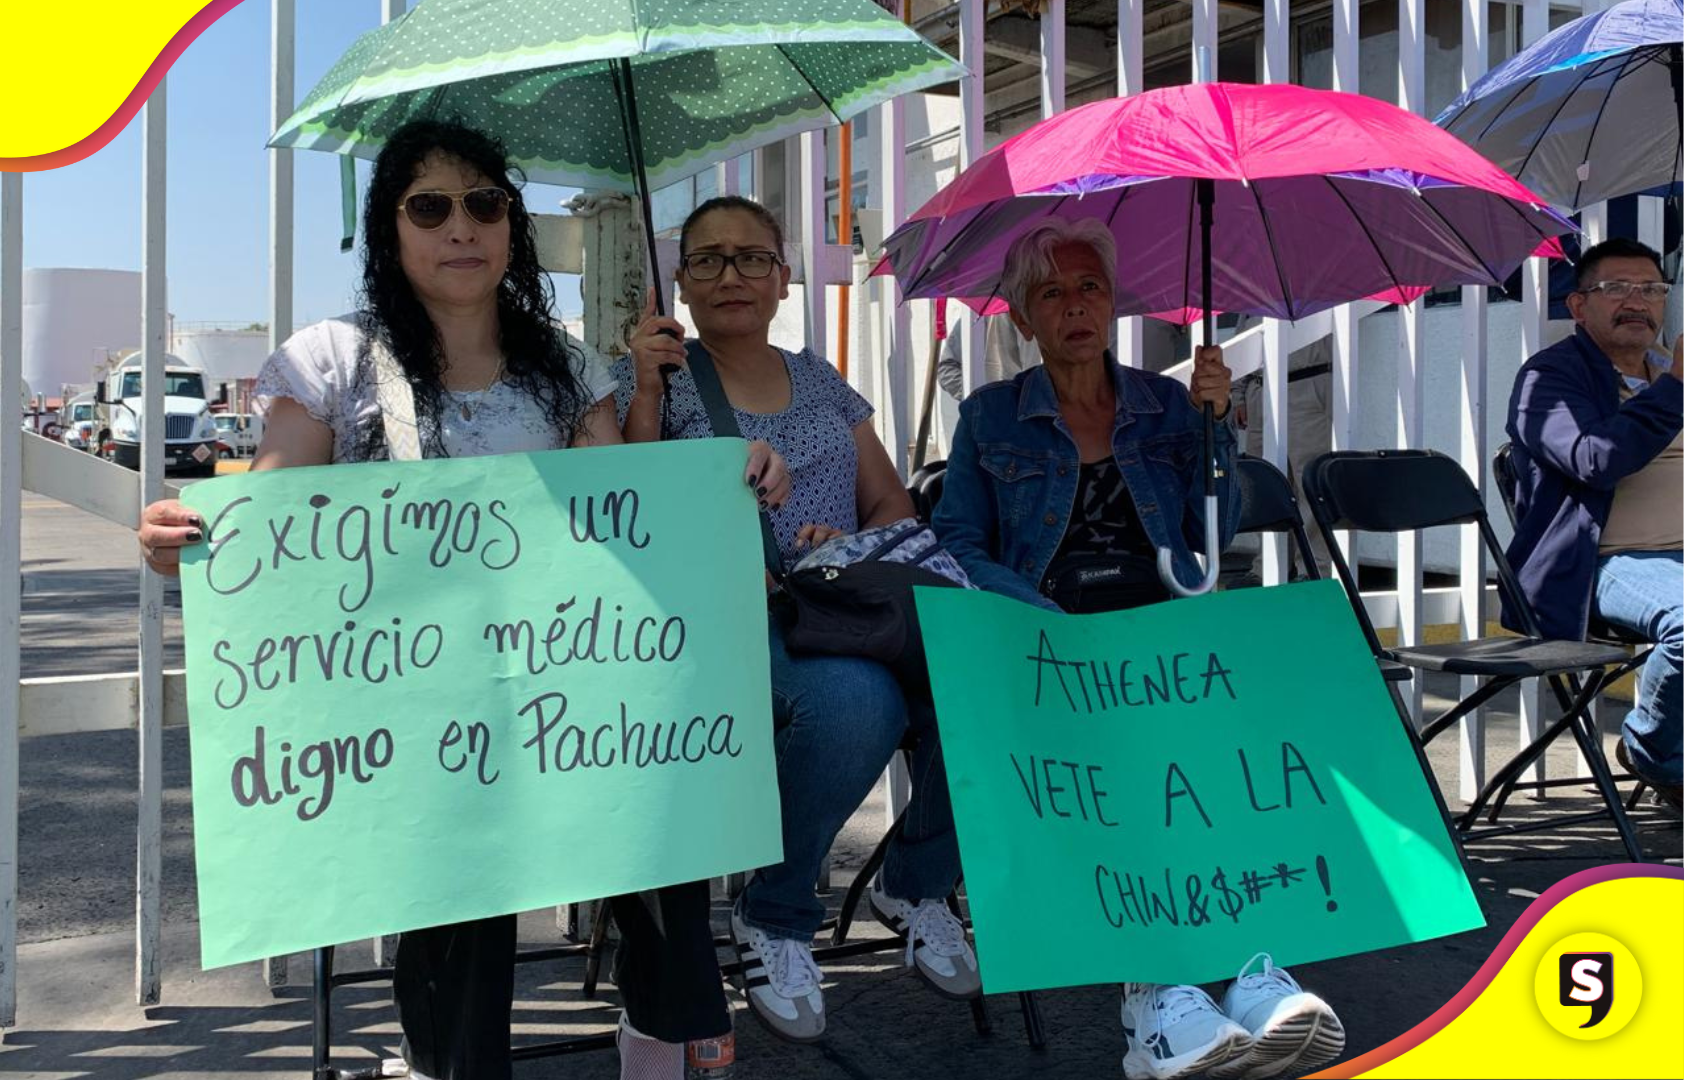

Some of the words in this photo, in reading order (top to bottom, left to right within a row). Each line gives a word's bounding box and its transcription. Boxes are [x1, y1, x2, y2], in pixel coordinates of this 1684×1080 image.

[569, 488, 650, 549] un
[213, 620, 443, 710] servicio
[483, 595, 686, 675] médico
[1026, 628, 1237, 713] ATHENEA
[231, 726, 394, 821] digno
[438, 719, 500, 785] en
[517, 692, 743, 773] Pachuca
[1009, 752, 1119, 826] VETE
[1165, 762, 1213, 828] A
[1237, 742, 1327, 812] LA
